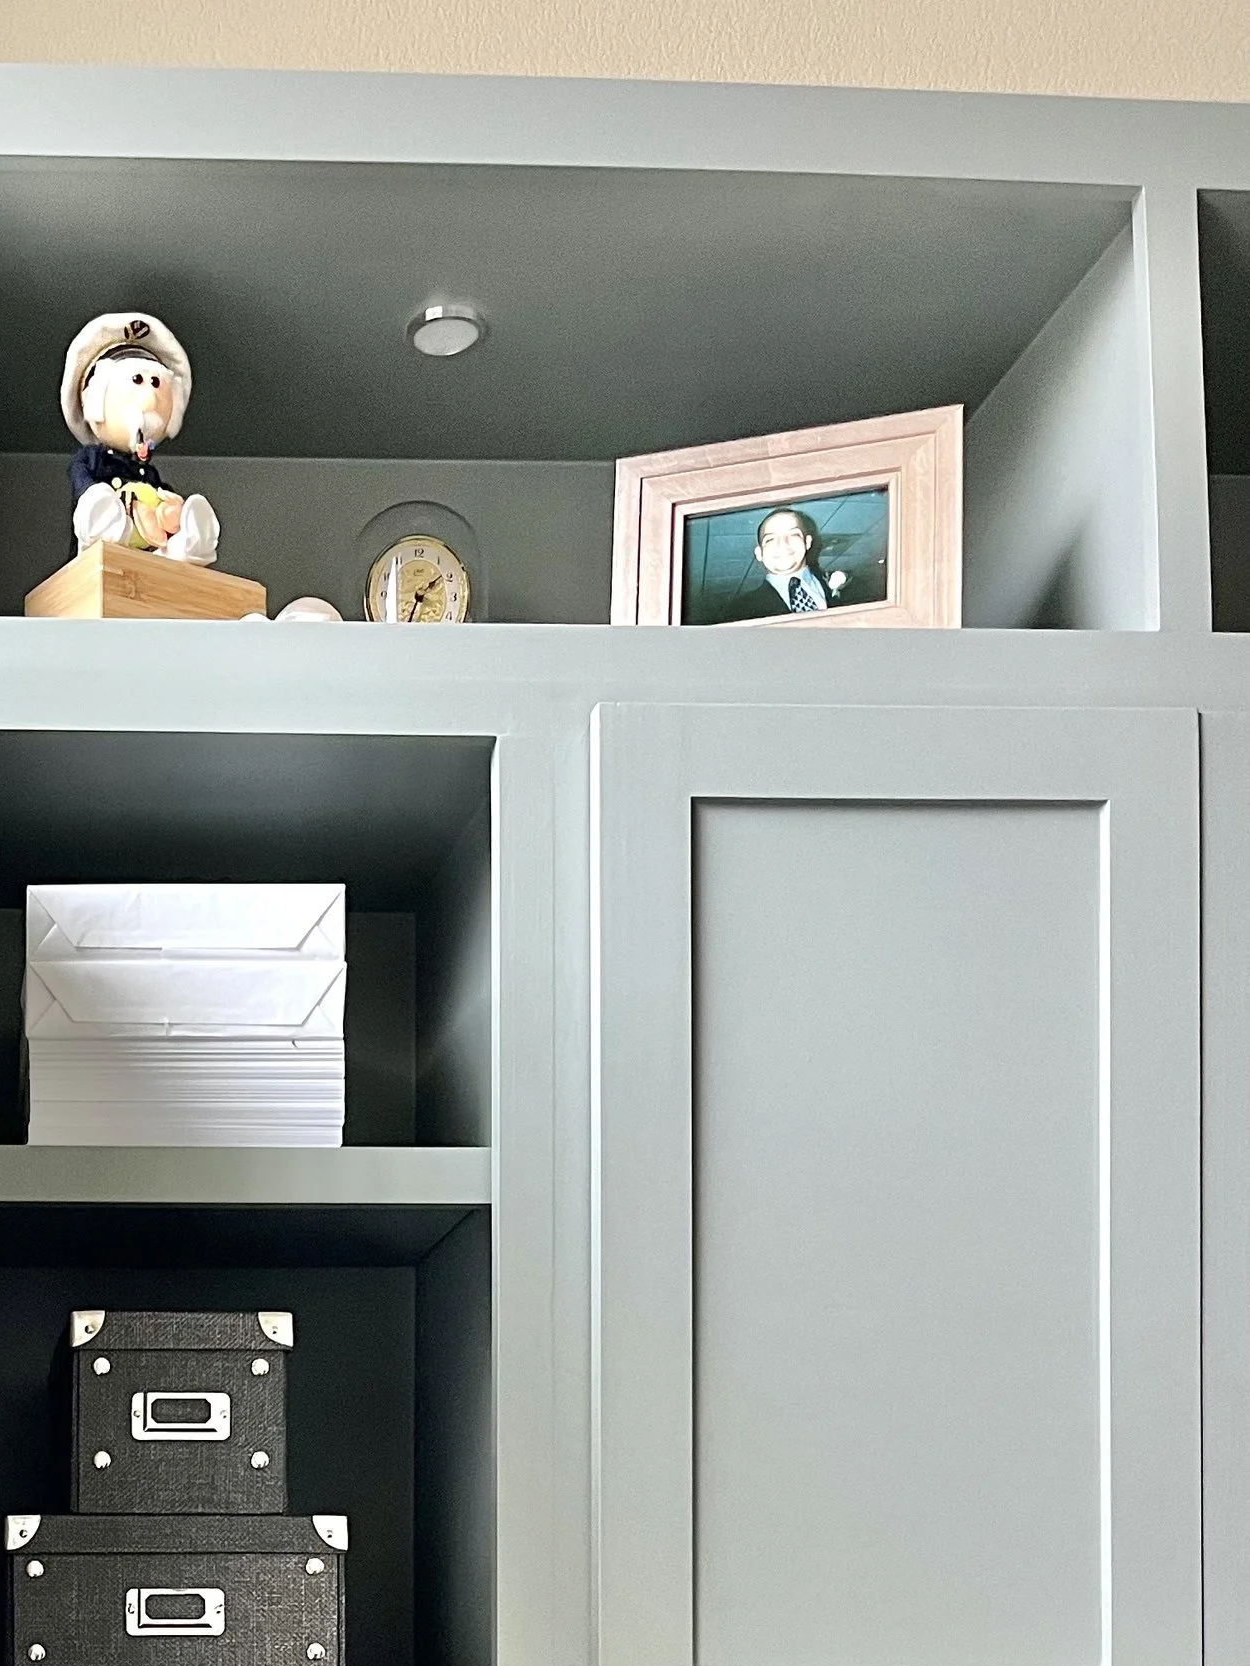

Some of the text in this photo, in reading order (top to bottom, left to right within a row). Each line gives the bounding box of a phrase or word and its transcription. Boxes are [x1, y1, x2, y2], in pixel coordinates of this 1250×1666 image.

[414, 548, 425, 558] 12
[446, 573, 453, 582] 2
[451, 593, 457, 602] 3
